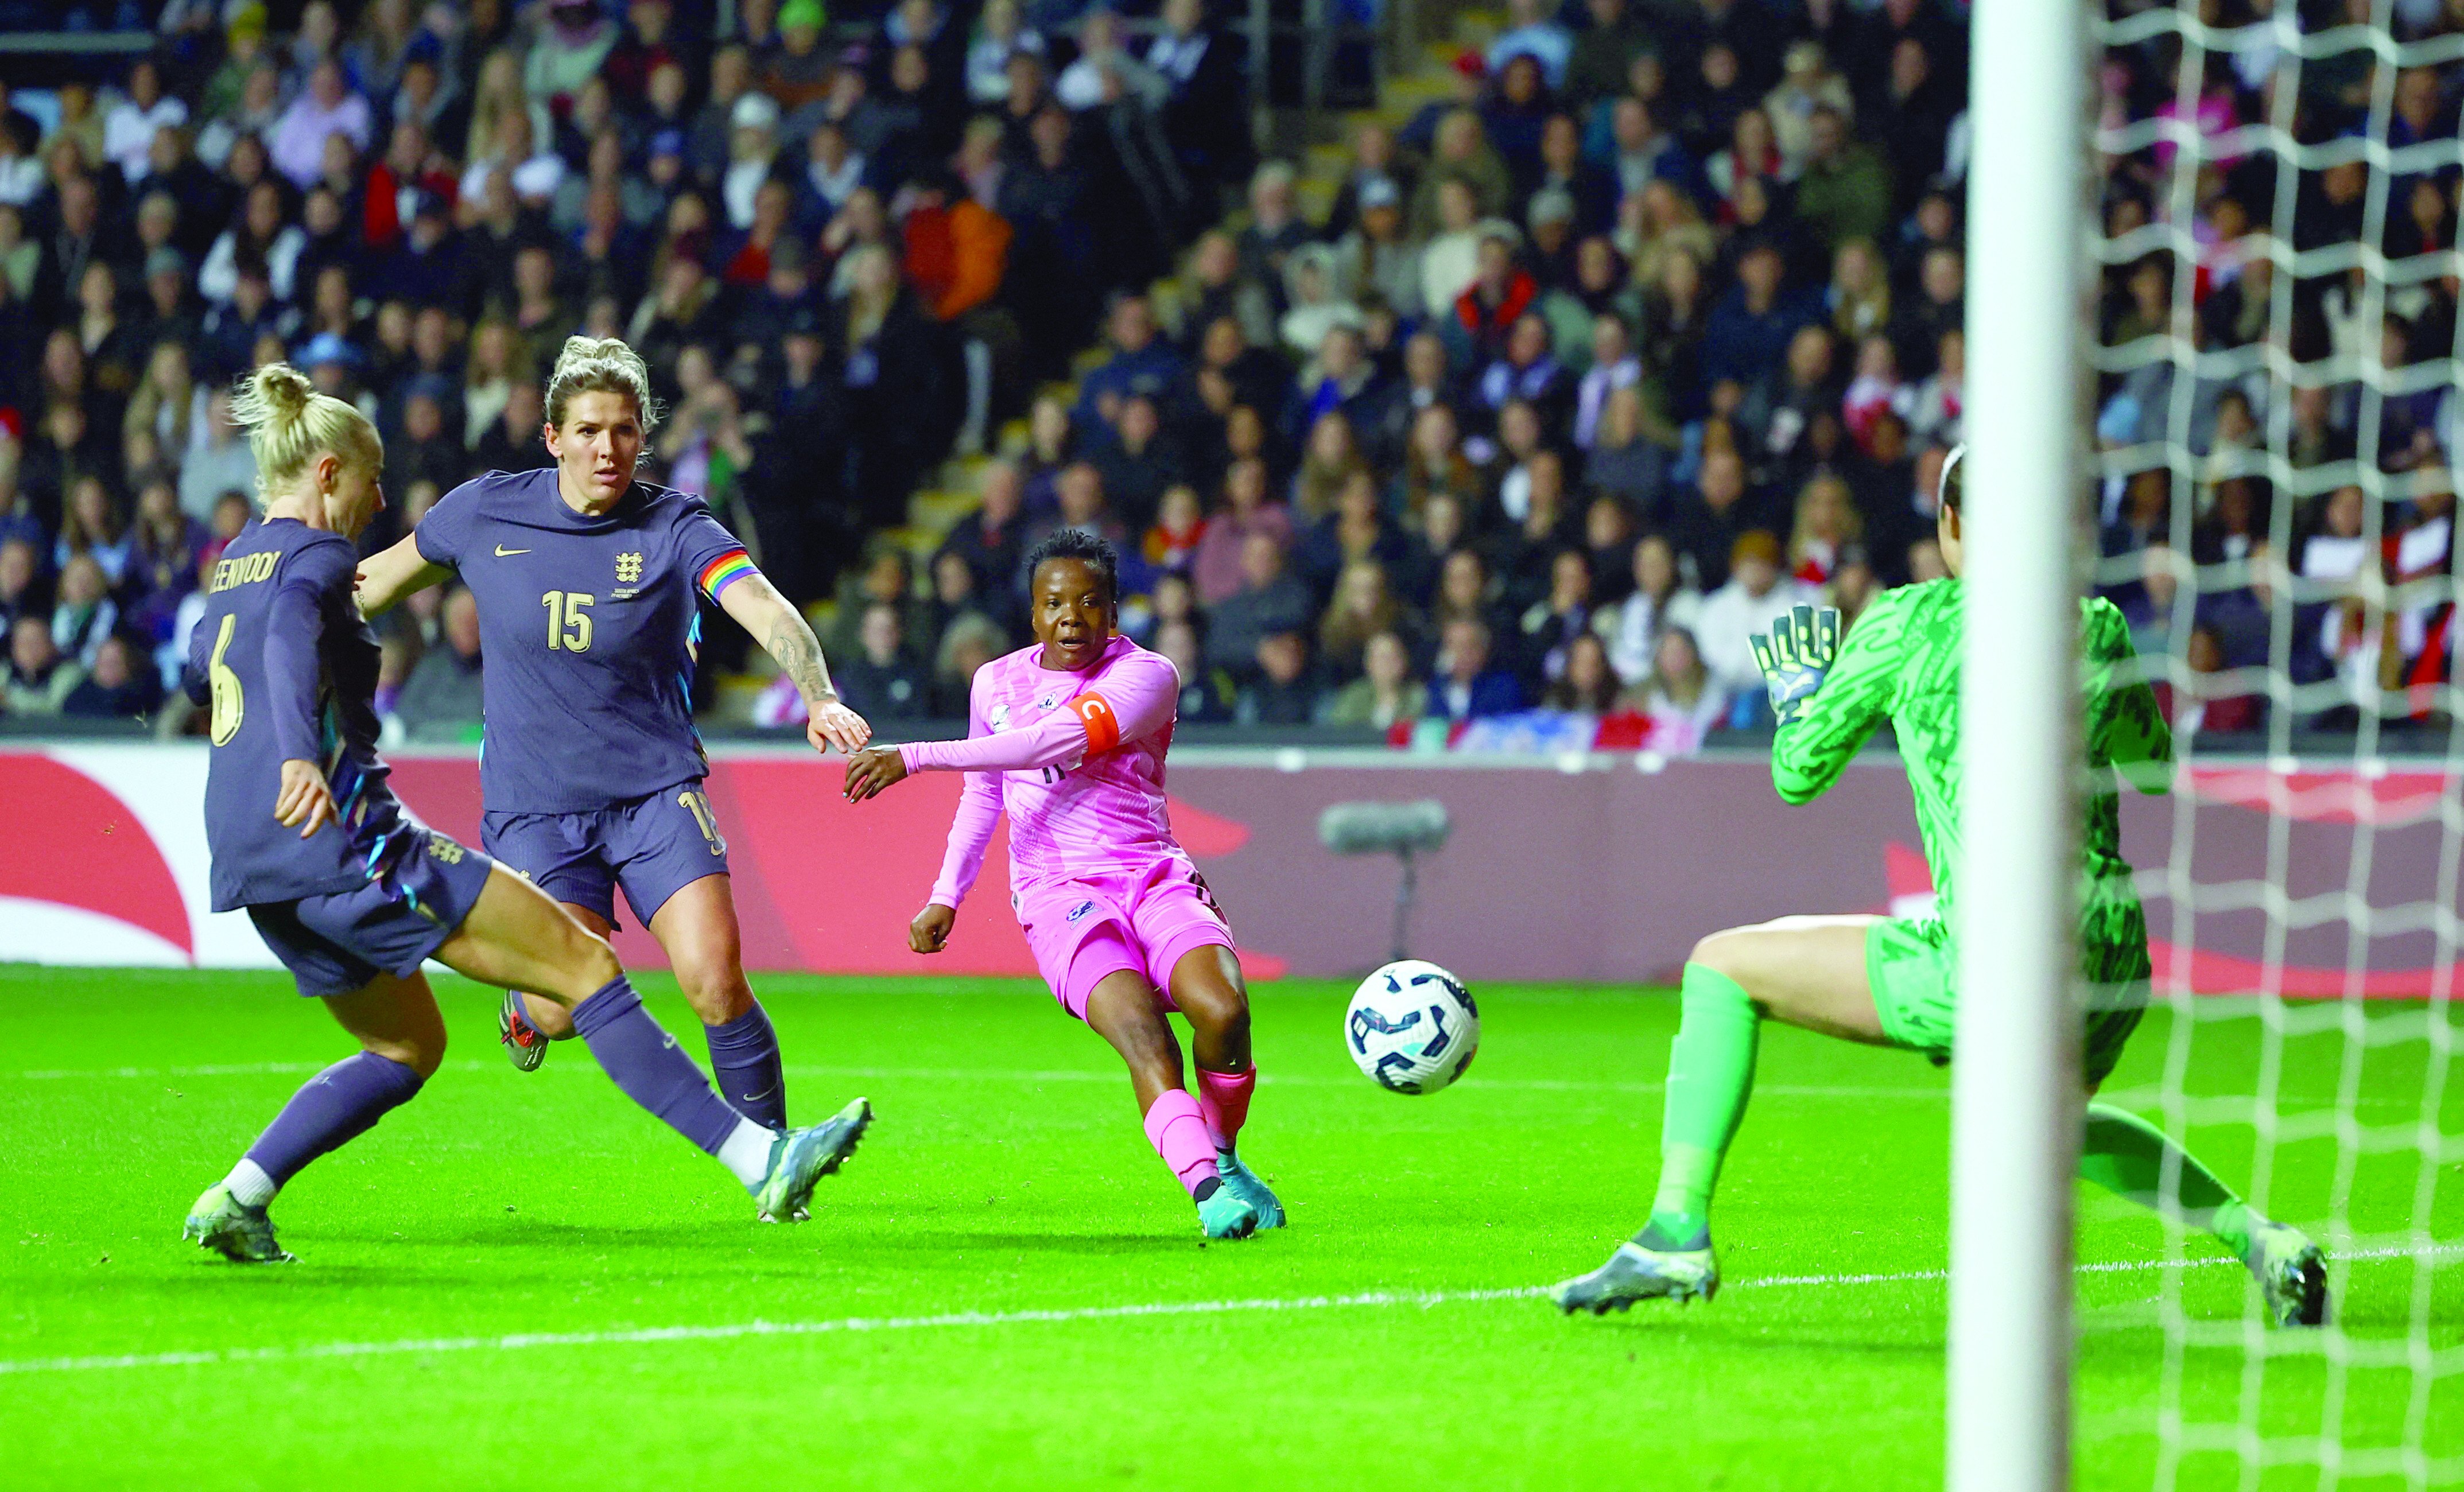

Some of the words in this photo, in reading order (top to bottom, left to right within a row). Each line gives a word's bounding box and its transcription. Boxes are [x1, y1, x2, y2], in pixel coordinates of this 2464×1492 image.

[542, 590, 595, 653] 15
[209, 613, 244, 747] 6
[1082, 700, 1106, 720] C
